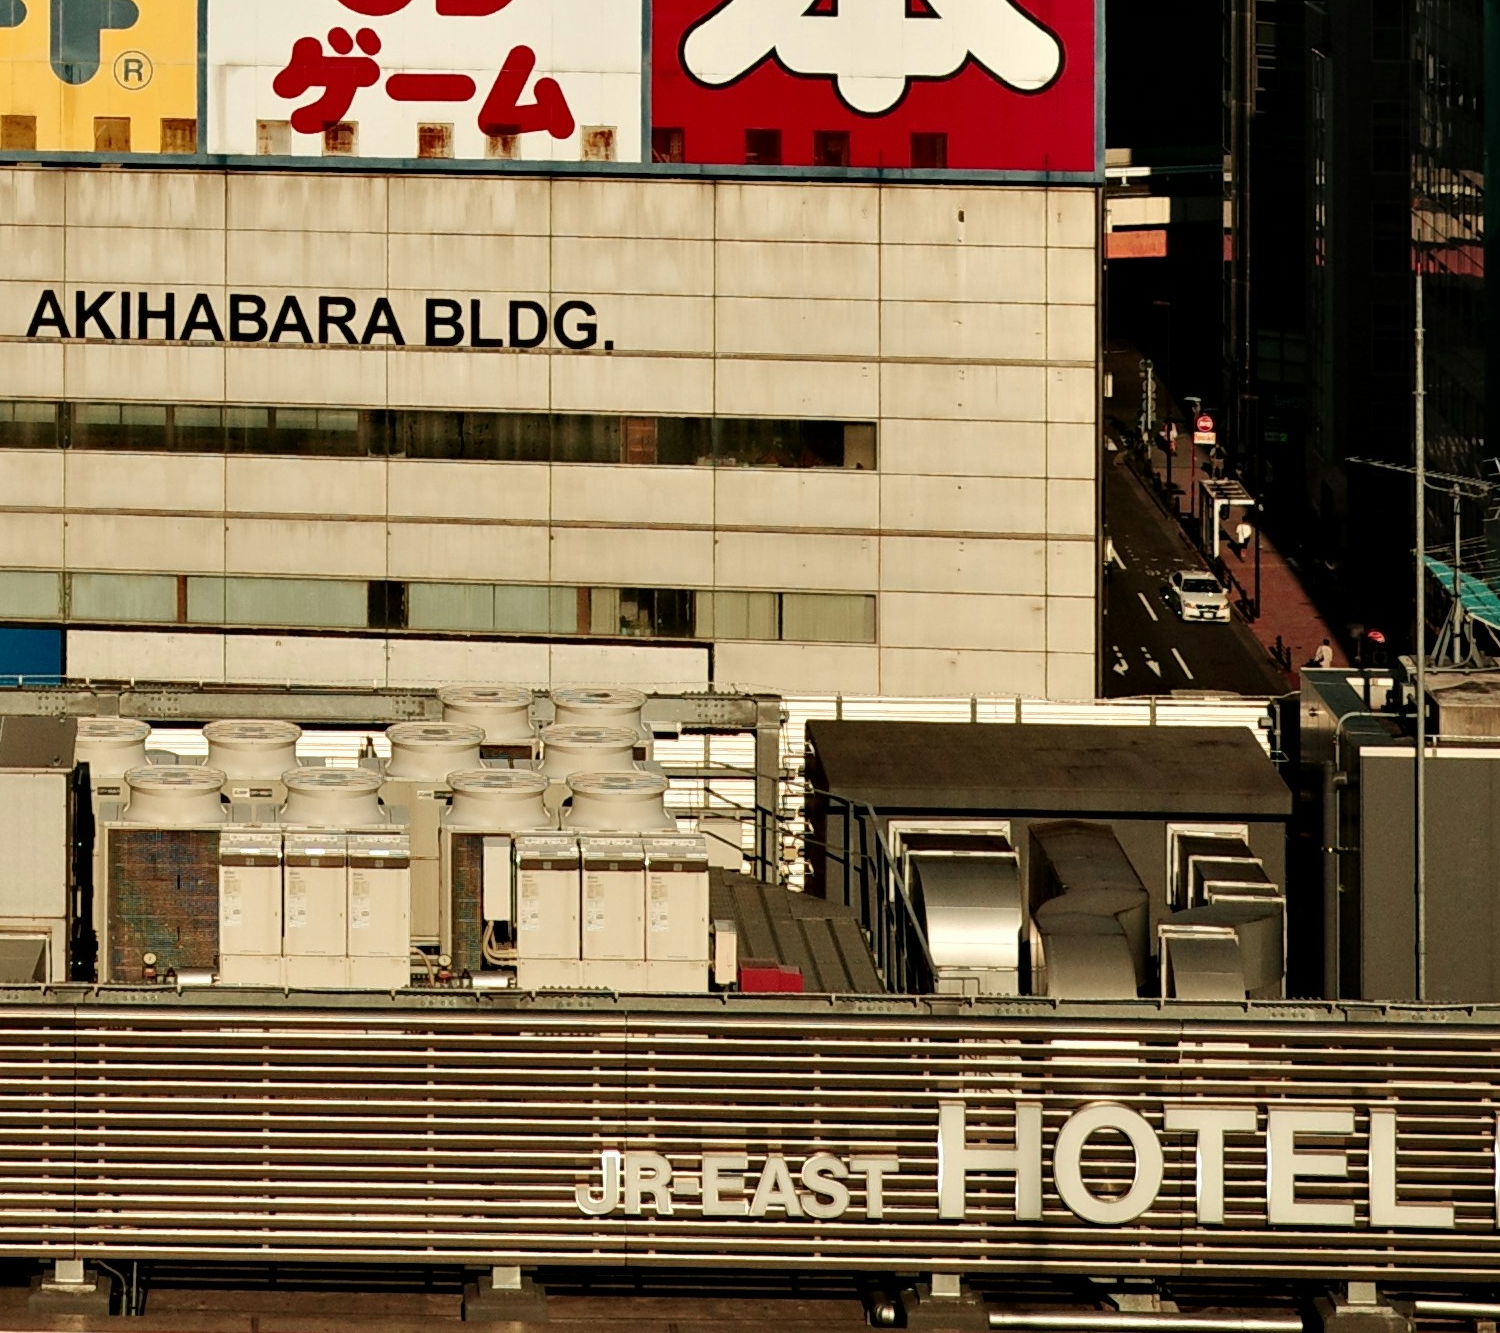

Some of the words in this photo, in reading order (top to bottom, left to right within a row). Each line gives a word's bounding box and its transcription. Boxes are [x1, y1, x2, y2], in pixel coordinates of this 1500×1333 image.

[272, 27, 575, 141] ゲーム
[26, 288, 401, 348] AKIHABARA
[423, 296, 616, 352] BLDG.
[577, 1148, 899, 1219] JR-EAST
[935, 1098, 1455, 1228] HOTEL
